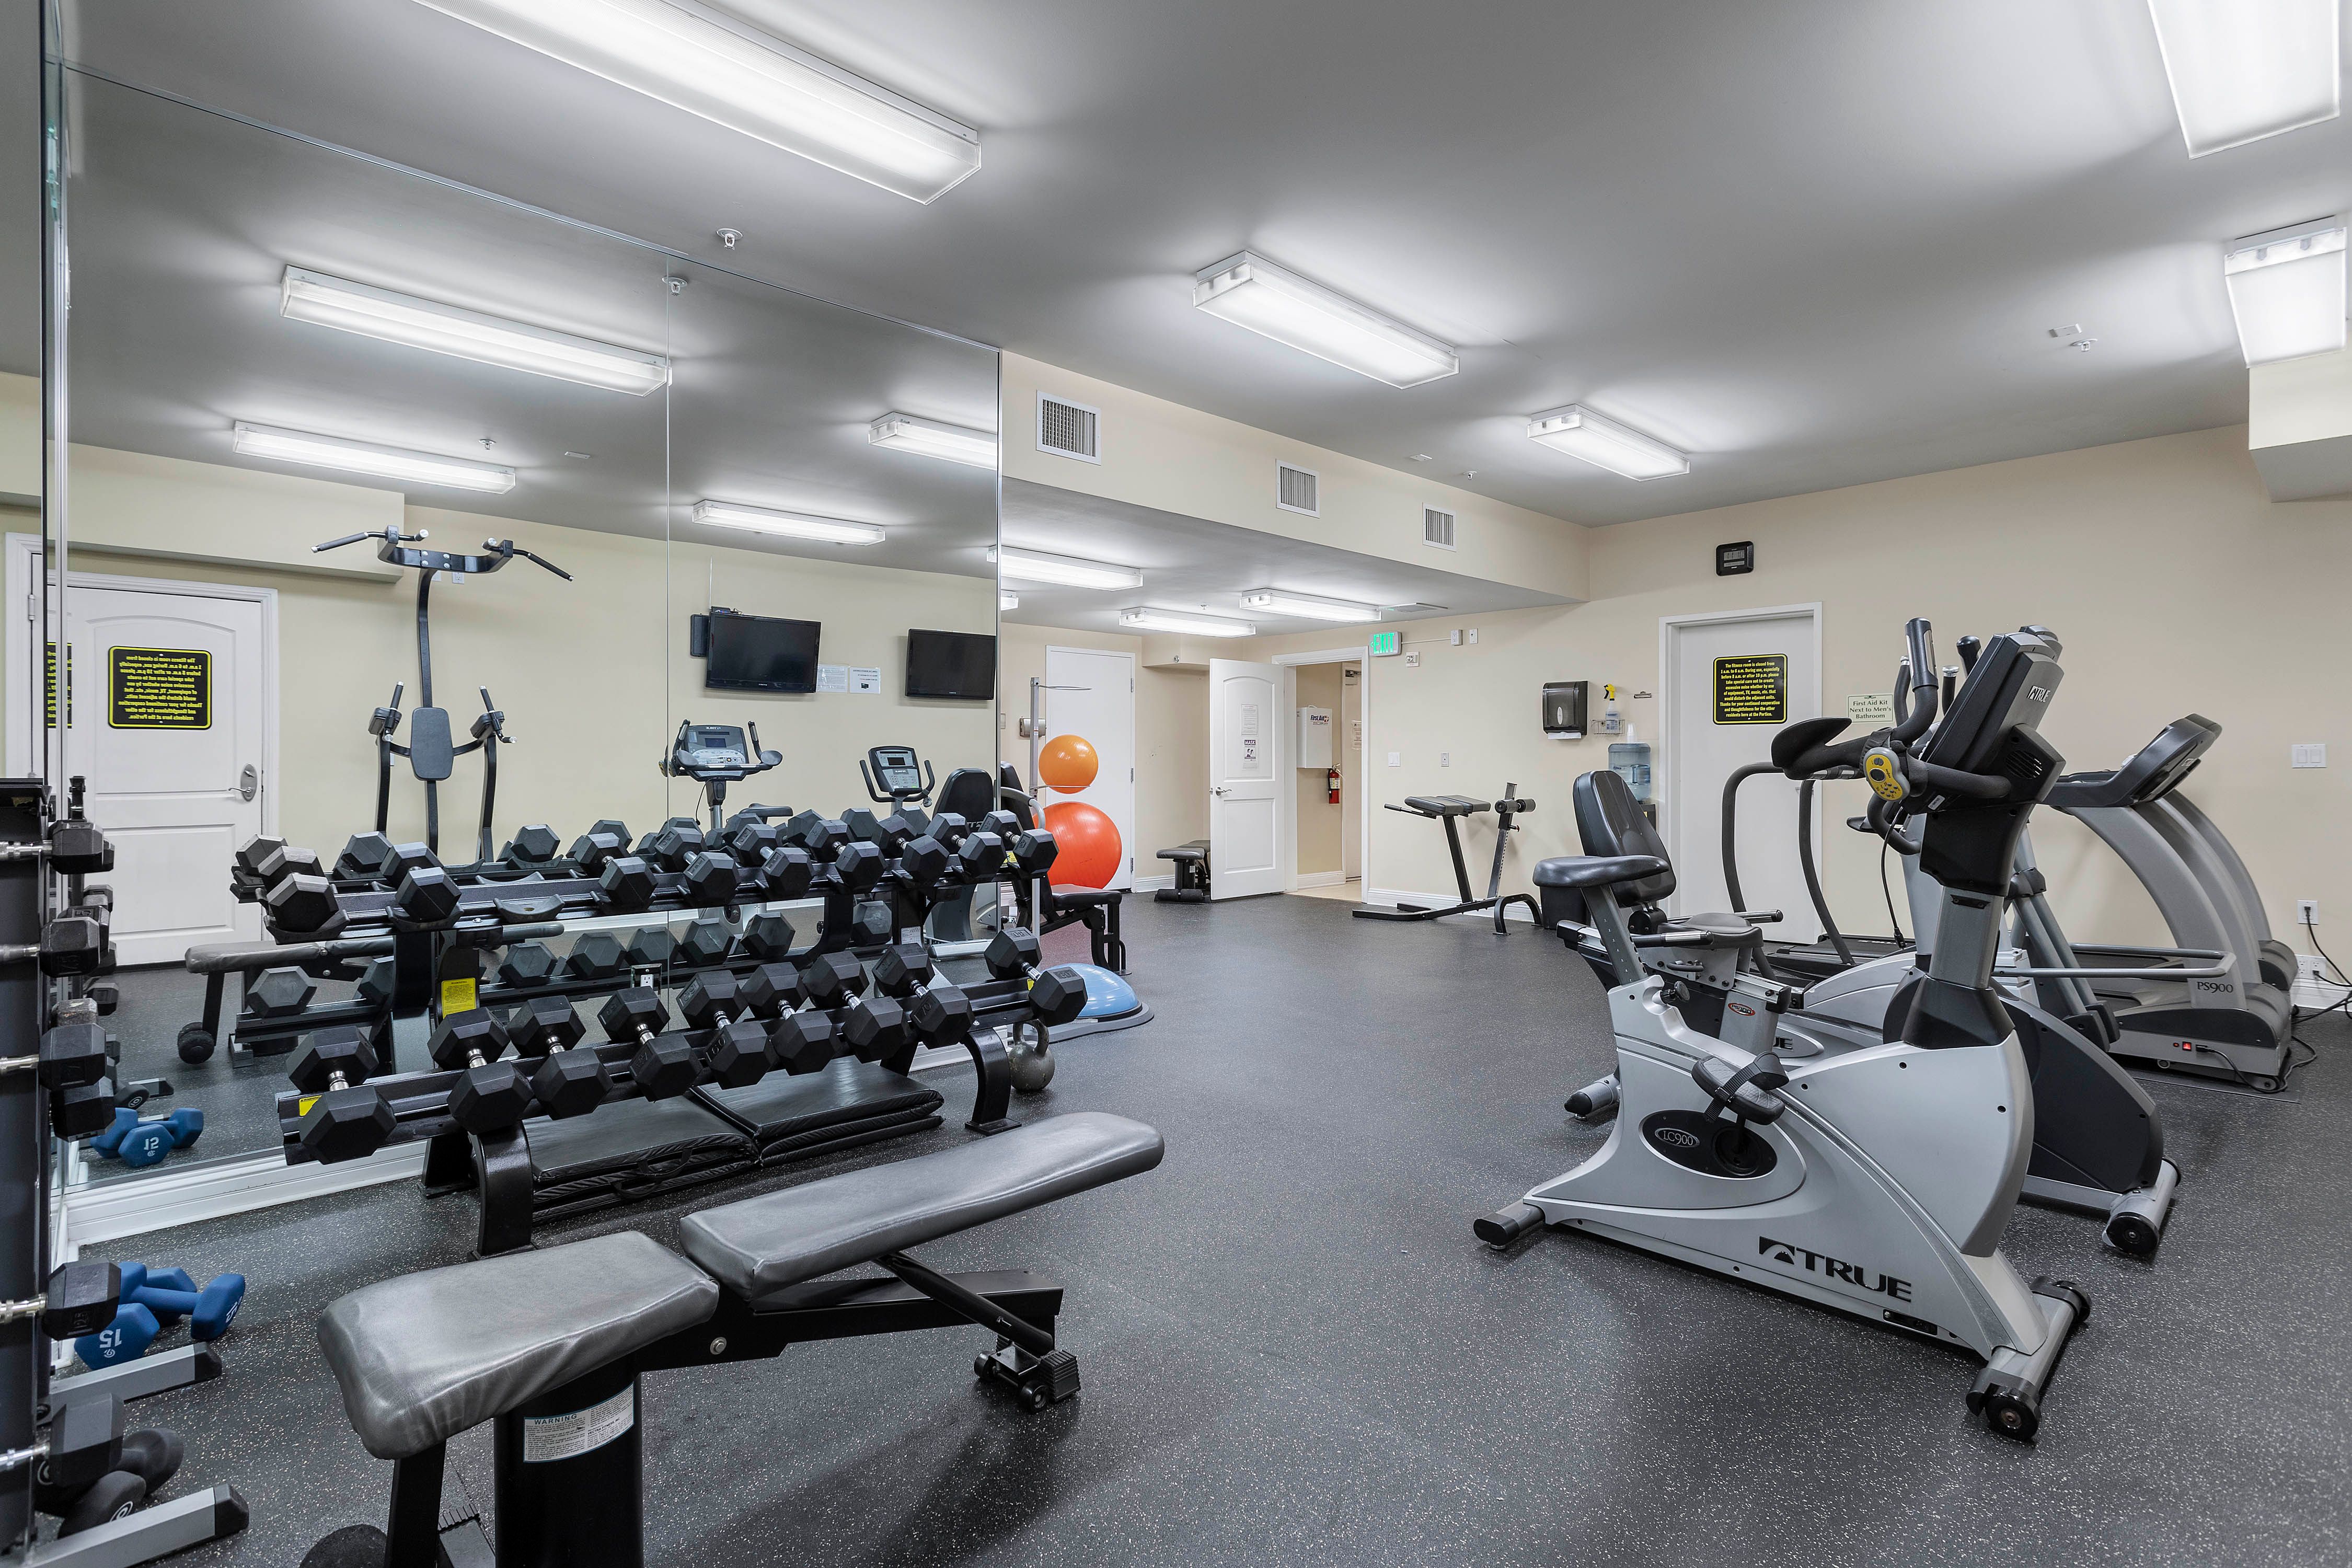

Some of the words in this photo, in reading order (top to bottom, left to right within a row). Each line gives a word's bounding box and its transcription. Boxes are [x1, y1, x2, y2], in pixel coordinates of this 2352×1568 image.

[1373, 632, 1394, 654] EXIT
[2034, 687, 2050, 702] TRUE
[2197, 981, 2233, 994] PS900
[1663, 1130, 1693, 1146] LC900
[1794, 1248, 1912, 1302] TRUE
[99, 1329, 122, 1348] 15
[535, 1414, 577, 1425] WARNING
